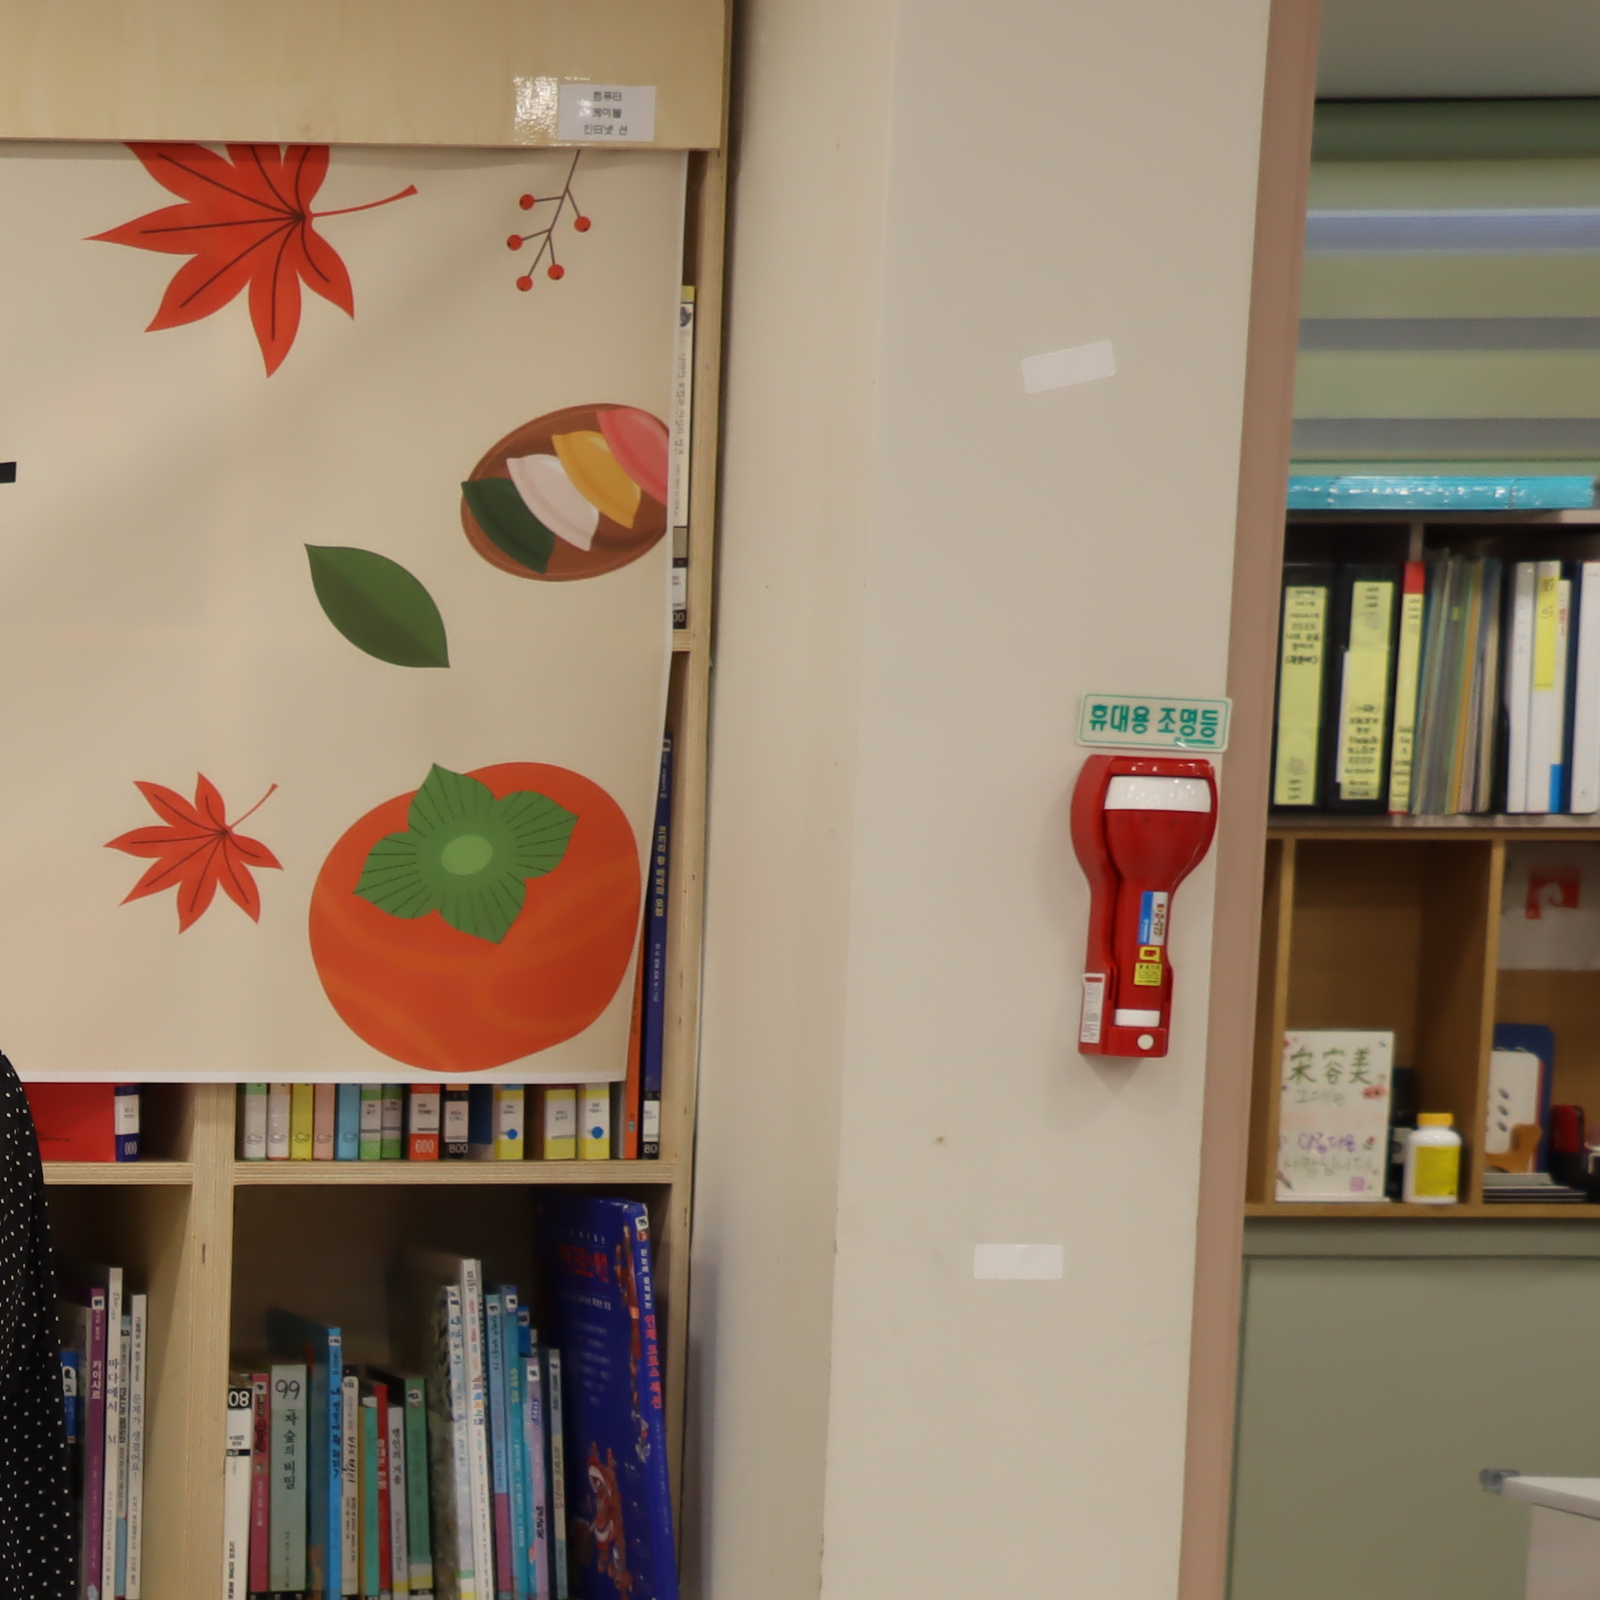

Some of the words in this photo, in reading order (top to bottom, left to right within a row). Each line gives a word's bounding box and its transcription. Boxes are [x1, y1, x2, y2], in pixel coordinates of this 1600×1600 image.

[1089, 704, 1150, 735] 휴대용
[1156, 707, 1220, 738] 조명등
[106, 1358, 120, 1413] 바다에서
[275, 1379, 300, 1400] 99
